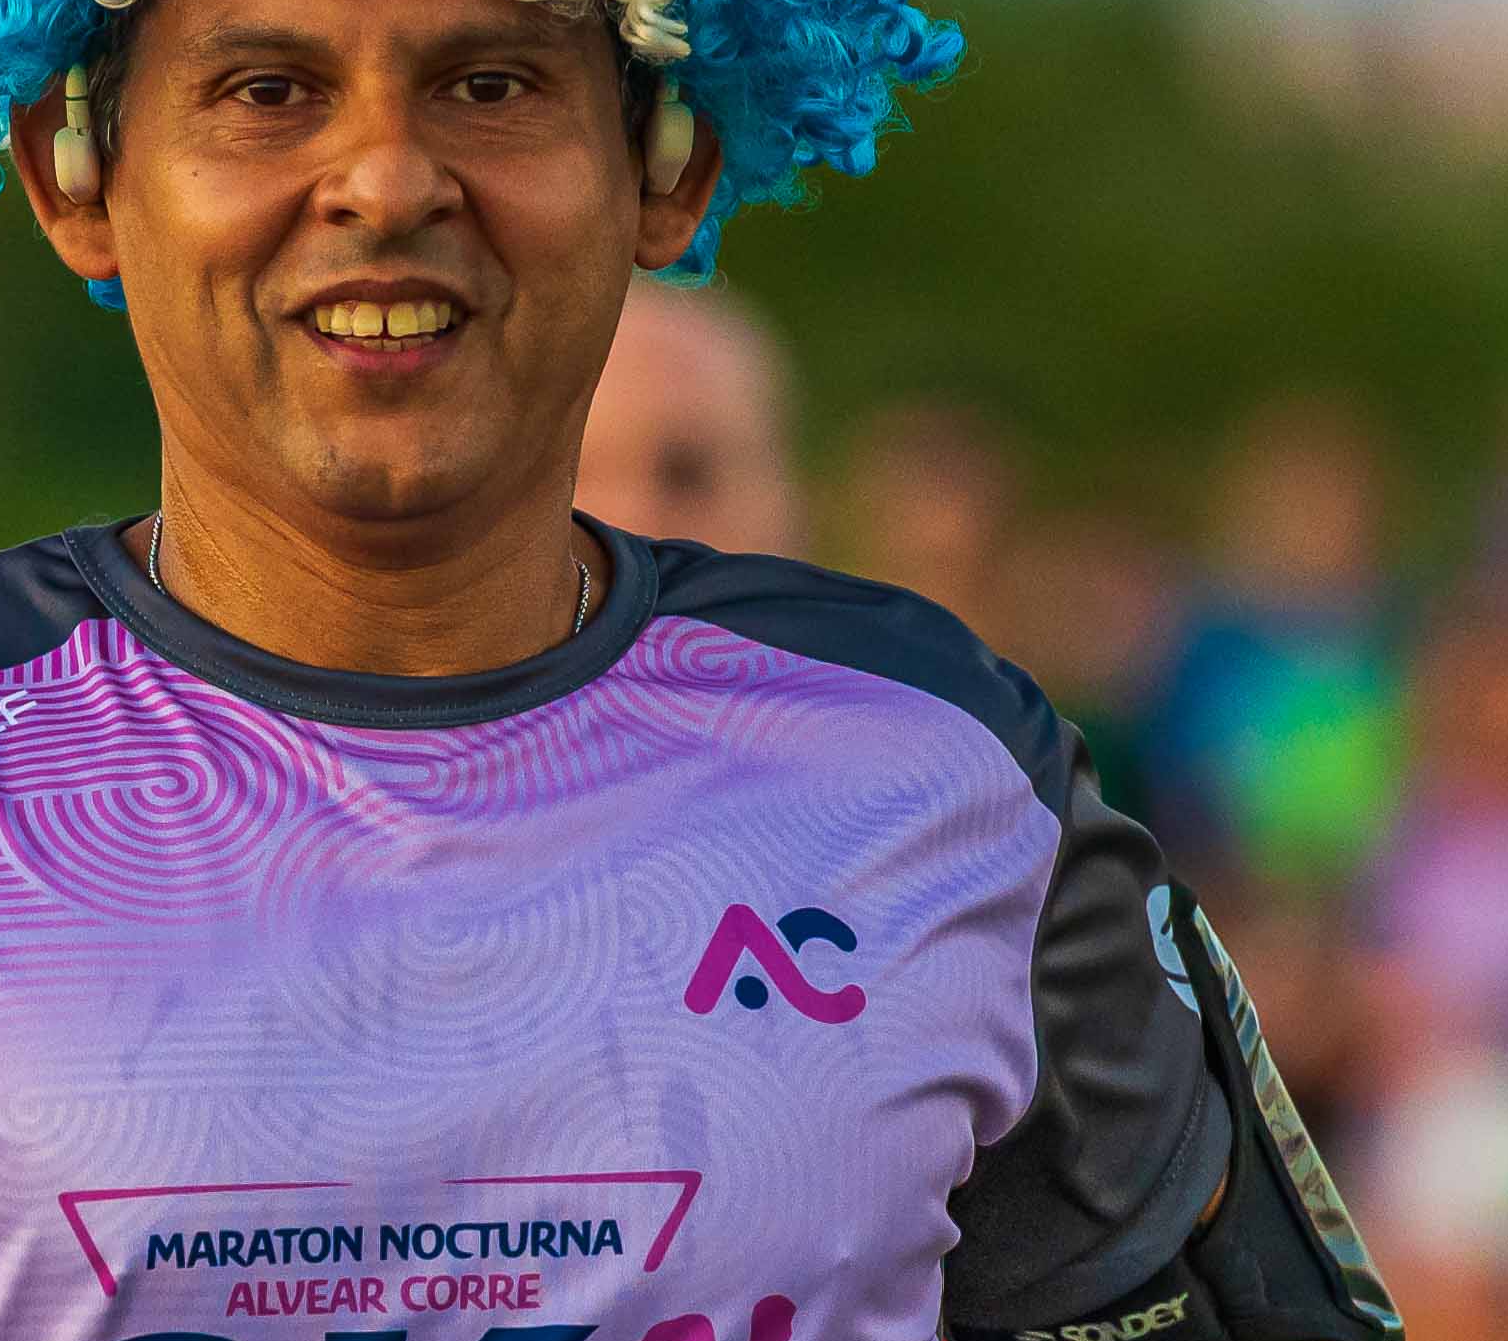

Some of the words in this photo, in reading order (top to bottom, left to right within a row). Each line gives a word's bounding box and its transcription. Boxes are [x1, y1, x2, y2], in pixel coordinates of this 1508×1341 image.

[146, 1225, 362, 1271] MARATON
[382, 1219, 624, 1261] NOCTURNA
[225, 1276, 389, 1317] ALVEAR
[399, 1273, 542, 1311] CORRE
